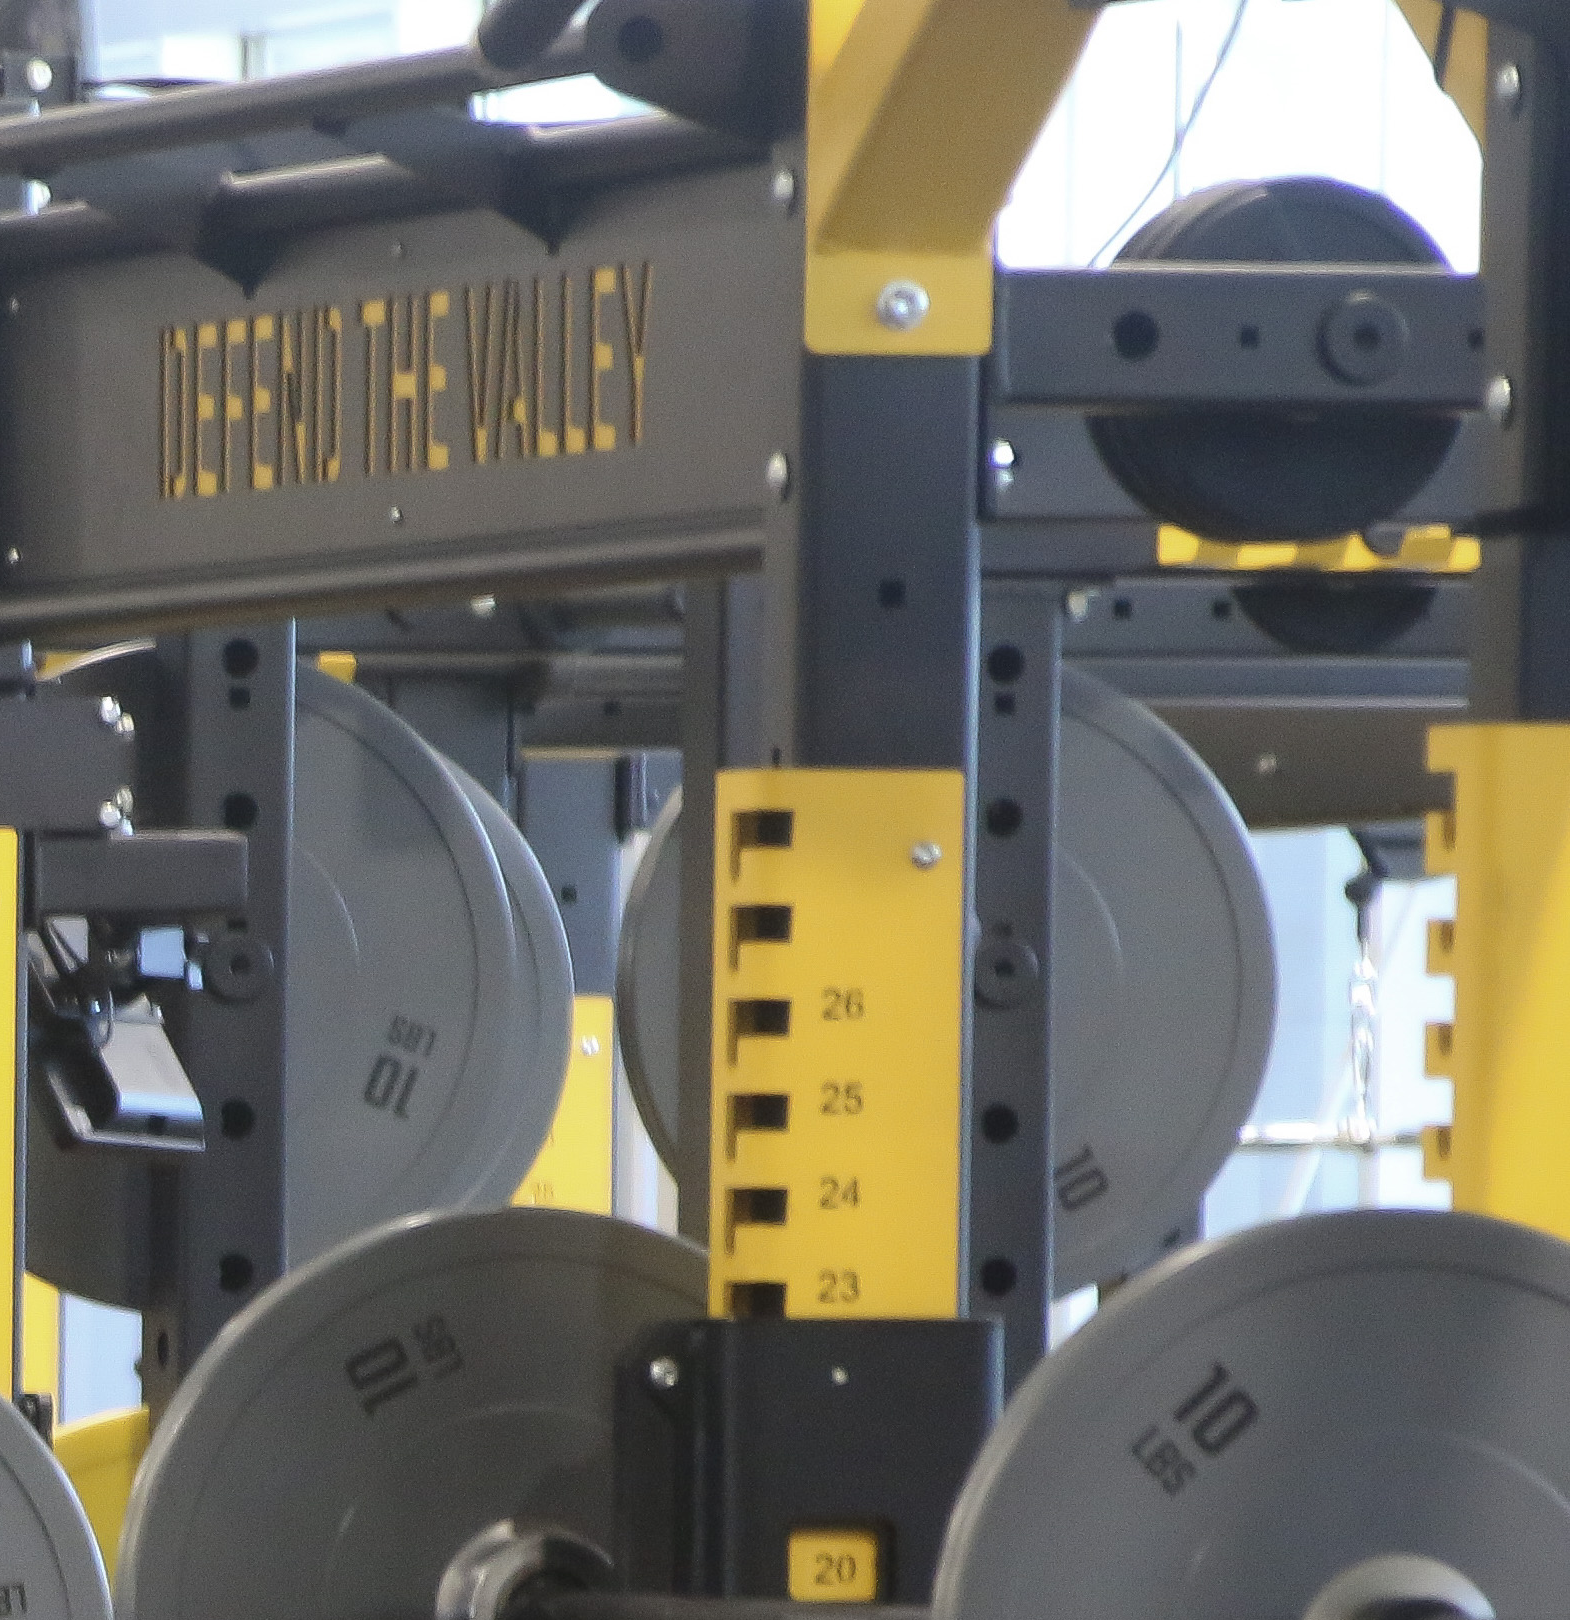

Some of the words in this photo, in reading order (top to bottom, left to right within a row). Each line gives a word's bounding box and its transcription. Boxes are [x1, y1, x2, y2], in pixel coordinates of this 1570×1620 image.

[162, 303, 344, 499] DEFEND
[359, 290, 452, 478] THE
[465, 261, 653, 464] VALLEY
[822, 988, 864, 1020] 26
[364, 1053, 420, 1119] 10
[820, 1083, 863, 1115] 25
[819, 1178, 860, 1209] 24
[818, 1272, 859, 1303] 23
[344, 1333, 419, 1416] 10
[1173, 1361, 1259, 1457] 10
[1130, 1424, 1198, 1497] LBS
[814, 1553, 857, 1585] 20
